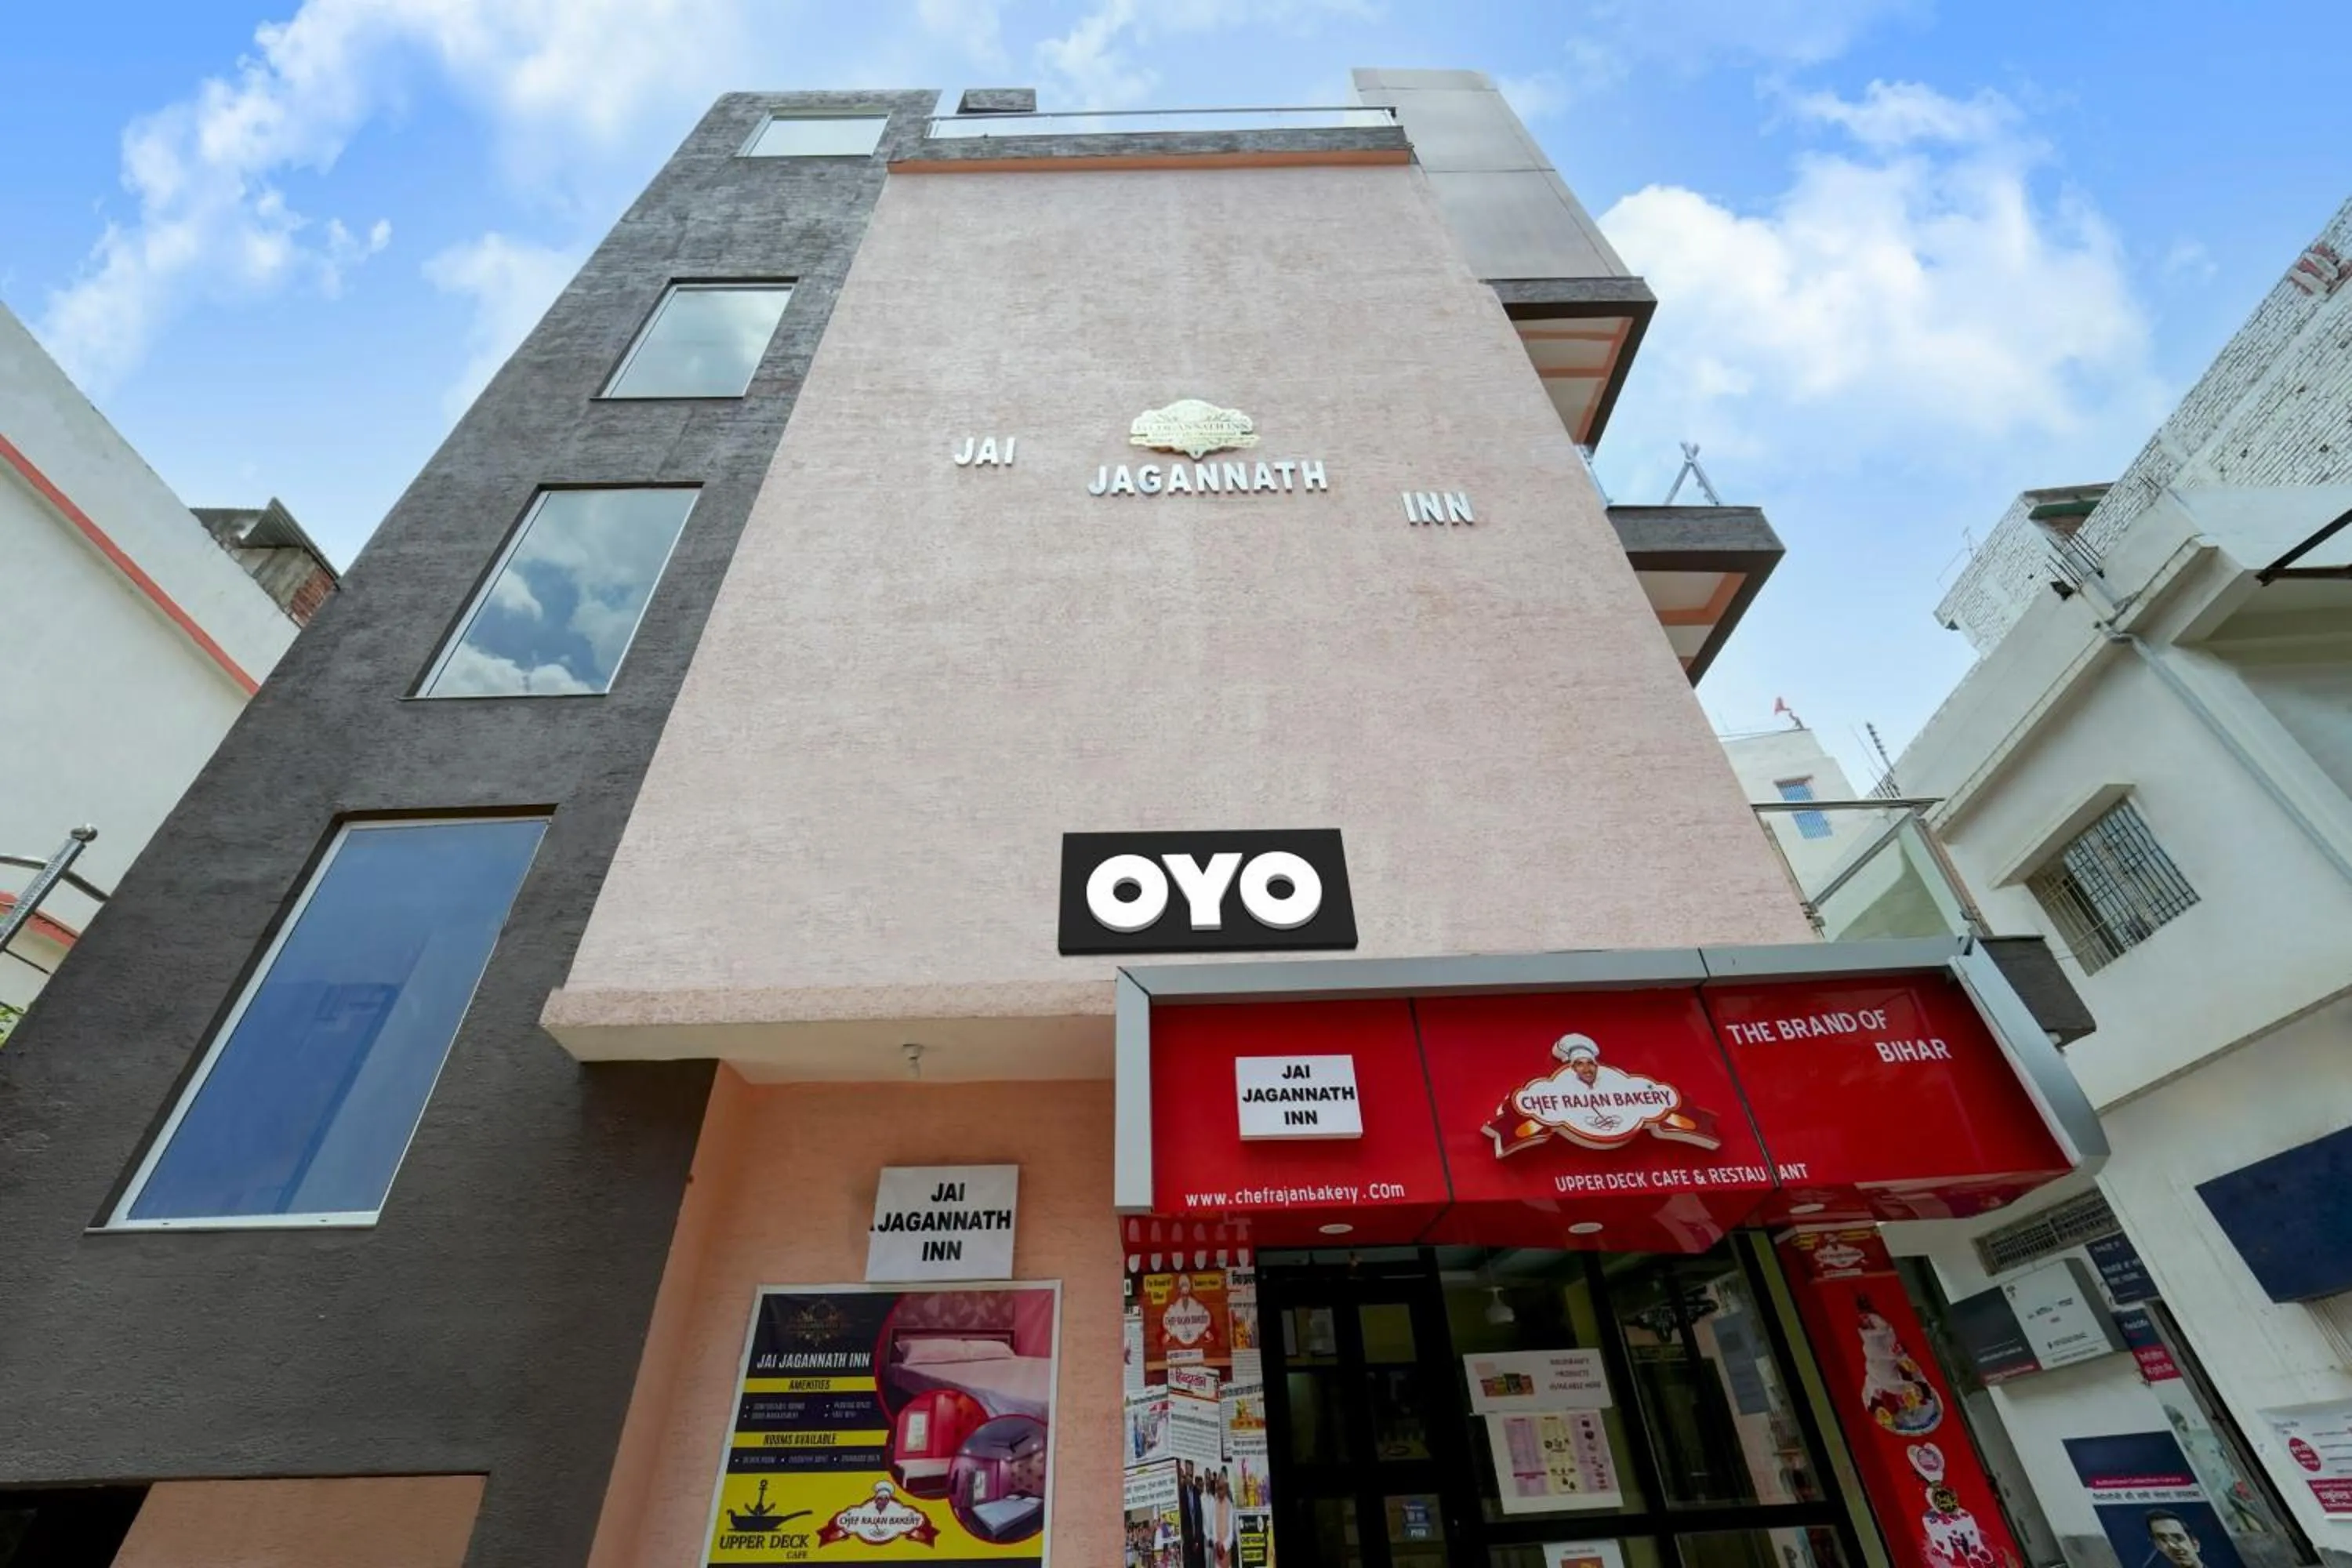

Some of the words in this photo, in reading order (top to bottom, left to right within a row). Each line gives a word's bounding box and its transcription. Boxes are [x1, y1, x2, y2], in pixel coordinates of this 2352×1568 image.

[953, 436, 1015, 466] JAI
[1088, 460, 1328, 496] JAGANNATH
[1401, 492, 1474, 524] INN
[1087, 851, 1323, 933] OYO
[1726, 1022, 1777, 1045] THE
[1776, 1012, 1857, 1040] BRAND
[1860, 1009, 1887, 1029] OF
[1875, 1039, 1952, 1062] BIHAR
[1282, 1065, 1310, 1080] JAI
[1242, 1086, 1356, 1103] JAGANNATH
[1522, 1094, 1559, 1114] CHEF
[1563, 1094, 1611, 1110] RAJAN
[1613, 1090, 1671, 1106] BAKERY
[1284, 1111, 1318, 1126] INN
[1555, 1173, 1604, 1192] UPPER
[1609, 1171, 1646, 1190] DECK
[1652, 1168, 1691, 1187] CAFE
[1695, 1169, 1707, 1185] &
[1708, 1163, 1808, 1184] RESTAUANT
[931, 1182, 965, 1202] JAI
[877, 1210, 1011, 1232] JAGANNATH
[921, 1240, 963, 1261] INN
[757, 1354, 777, 1369] JAI
[779, 1352, 847, 1368] JAGANNATH
[849, 1352, 871, 1367] INN
[788, 1379, 831, 1391] AMENITIES
[794, 1432, 838, 1445] AVAILABLE
[839, 1517, 859, 1526] CHEF
[861, 1517, 888, 1526] RAJAN
[888, 1516, 922, 1525] BAKERY
[719, 1535, 765, 1550] UPPER
[769, 1534, 810, 1549] DECK
[786, 1550, 808, 1559] CAFE
